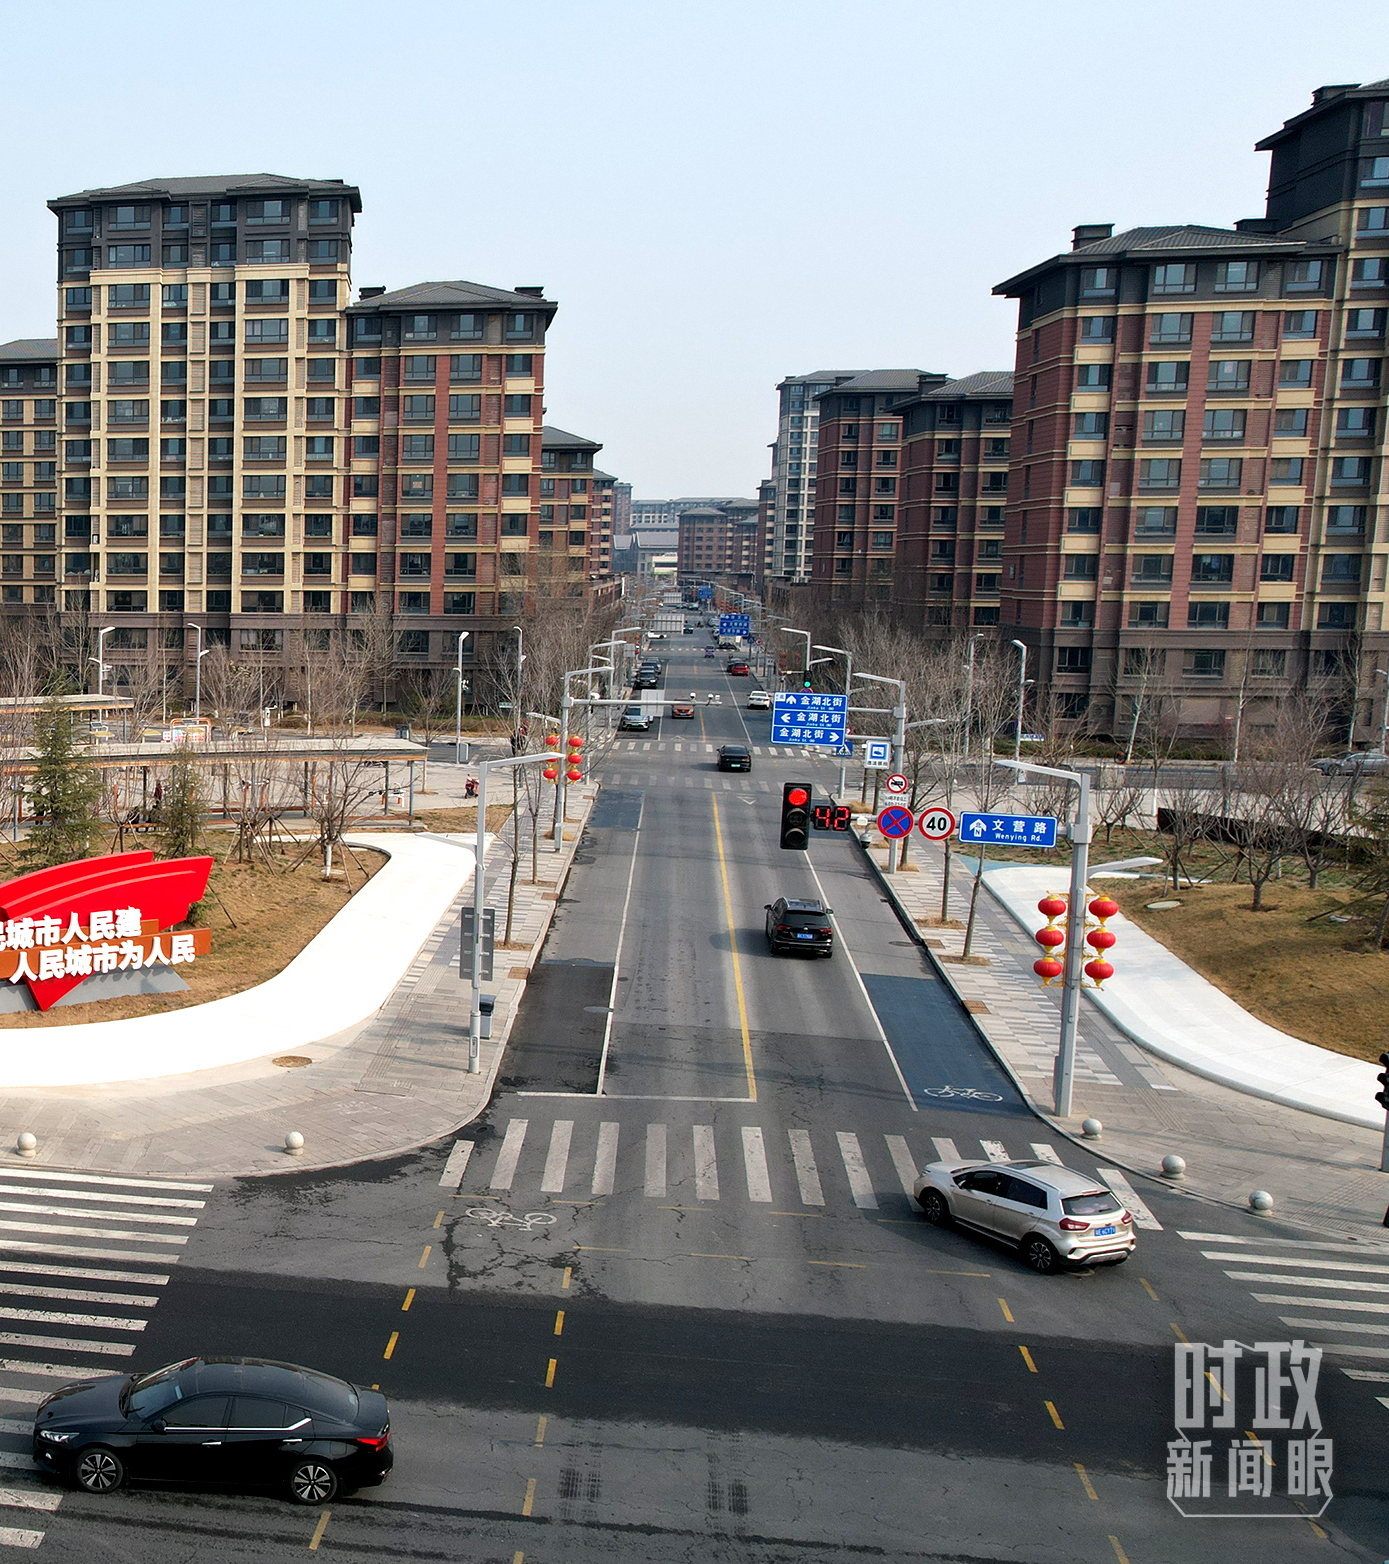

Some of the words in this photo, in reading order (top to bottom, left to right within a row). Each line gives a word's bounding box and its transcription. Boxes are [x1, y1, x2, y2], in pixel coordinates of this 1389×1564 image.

[800, 695, 843, 707] 金湖北街
[796, 711, 841, 724] 金湖北街
[779, 727, 825, 739] 金湖北街
[815, 807, 850, 830] 42
[926, 816, 947, 832] 40
[992, 818, 1047, 835] 文营路
[995, 833, 1027, 842] Wenying
[1030, 834, 1042, 842] Rd.
[8, 933, 196, 984] 人民城市为人民
